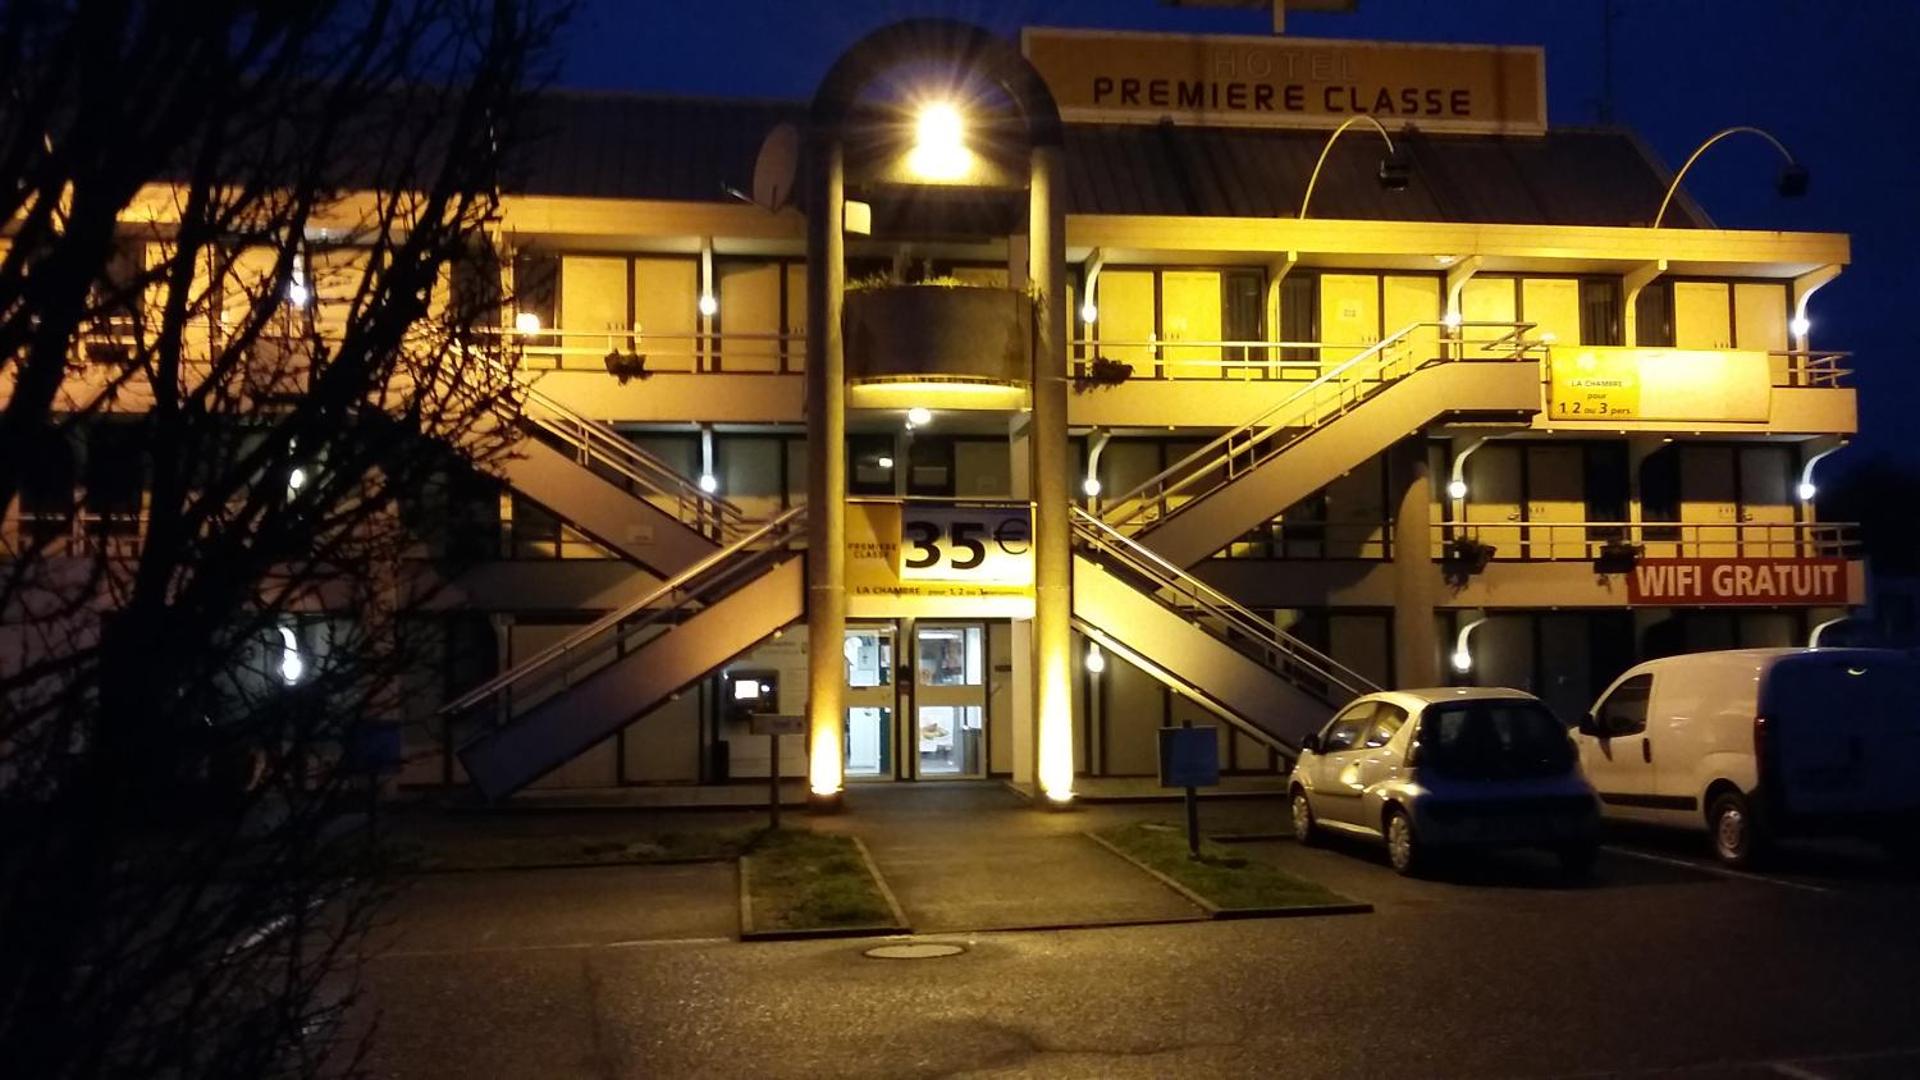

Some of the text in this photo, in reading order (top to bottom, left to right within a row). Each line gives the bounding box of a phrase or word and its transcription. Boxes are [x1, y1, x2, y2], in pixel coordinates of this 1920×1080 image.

[1213, 49, 1354, 81] HOTEL
[1094, 77, 1471, 116] PREMIERE CLASSE
[1572, 402, 1581, 414] 2
[1600, 402, 1608, 414] 3
[856, 586, 870, 595] LA
[1635, 564, 1838, 597] WIFI GRATUIT
